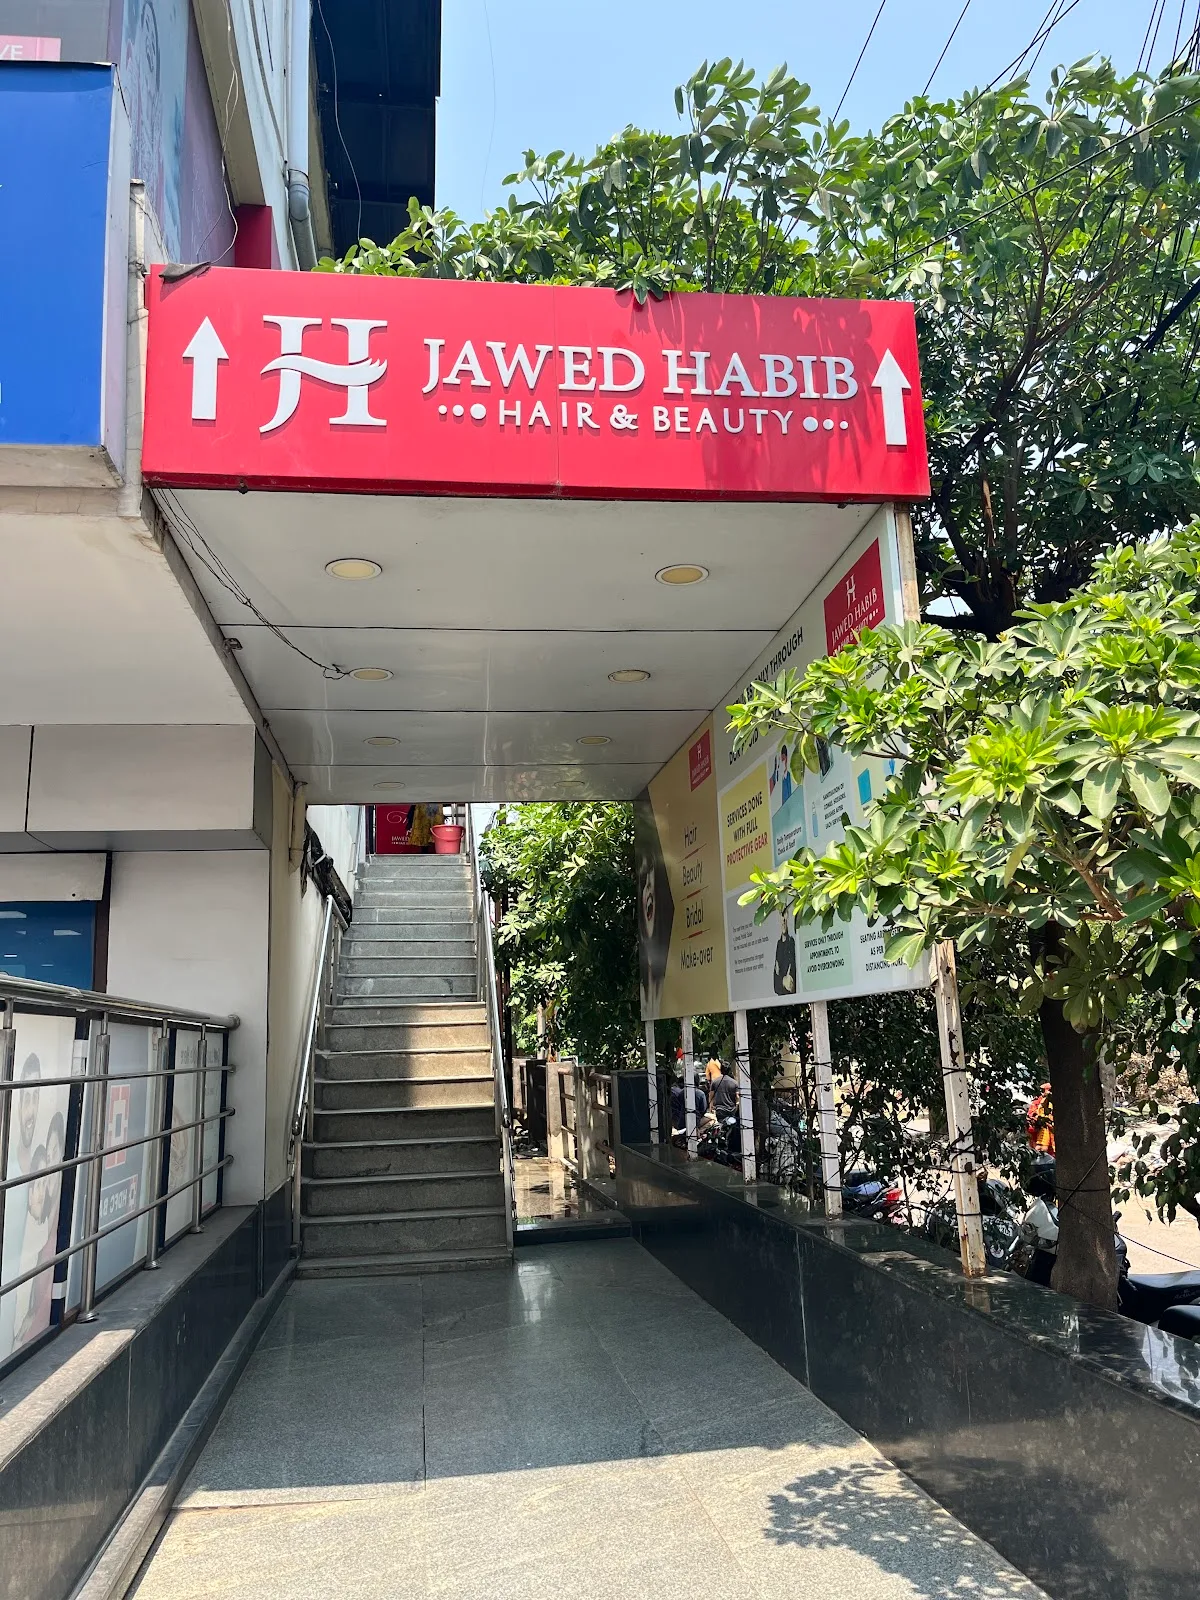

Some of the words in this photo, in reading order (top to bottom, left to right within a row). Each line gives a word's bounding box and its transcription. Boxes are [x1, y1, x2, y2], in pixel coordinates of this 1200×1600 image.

[421, 338, 645, 394] JAWED
[661, 349, 859, 400] HABIB
[499, 399, 601, 430] HAIR
[609, 404, 639, 431] &
[653, 405, 794, 435] BEAUTY
[831, 612, 854, 647] JAWED
[854, 587, 878, 621] HABIB
[769, 626, 804, 673] THROUGH
[726, 802, 748, 828] SERVICES
[748, 791, 763, 813] DONE
[684, 822, 698, 848] Hair
[733, 825, 746, 842] WITH
[746, 817, 758, 835] FULL
[727, 841, 754, 867] PROTECTIVE
[754, 832, 768, 851] GEAR
[682, 859, 703, 886] Beauty
[686, 899, 704, 928] Bridal
[860, 932, 876, 944] SEATING
[870, 946, 876, 956] AS
[680, 946, 714, 970] Make-over
[865, 960, 890, 971] DISTANCING
